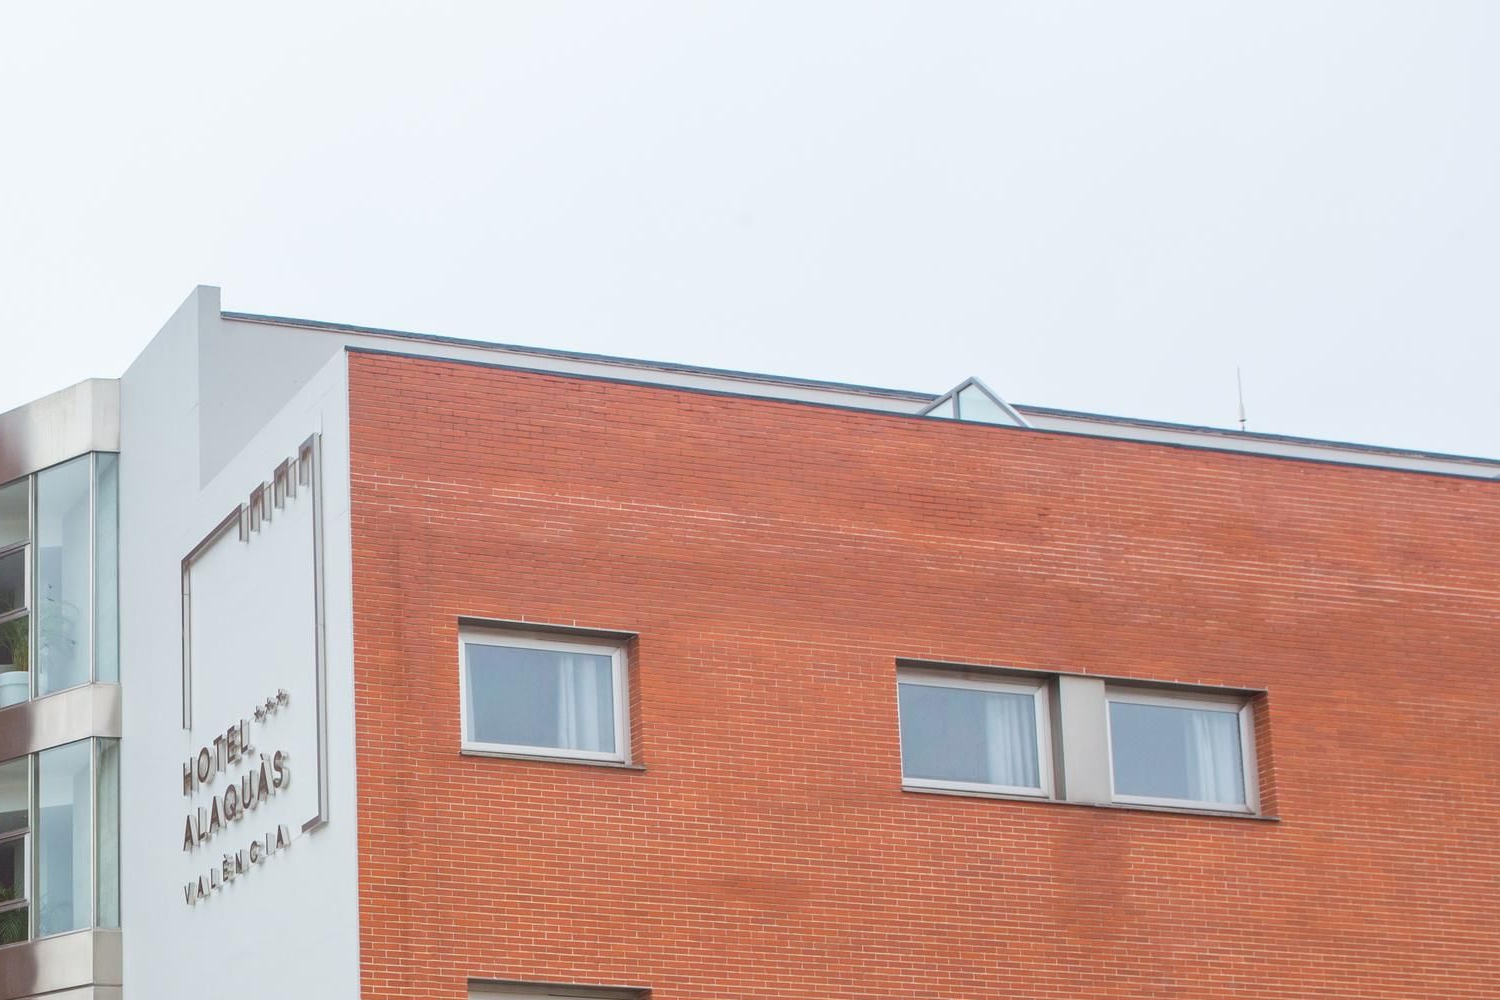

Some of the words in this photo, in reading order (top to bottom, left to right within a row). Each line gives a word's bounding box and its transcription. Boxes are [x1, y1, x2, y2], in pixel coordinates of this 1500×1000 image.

[182, 718, 255, 797] HOTEL
[182, 749, 291, 852] ALAQUÀS
[183, 823, 291, 905] VALÈNCIA
